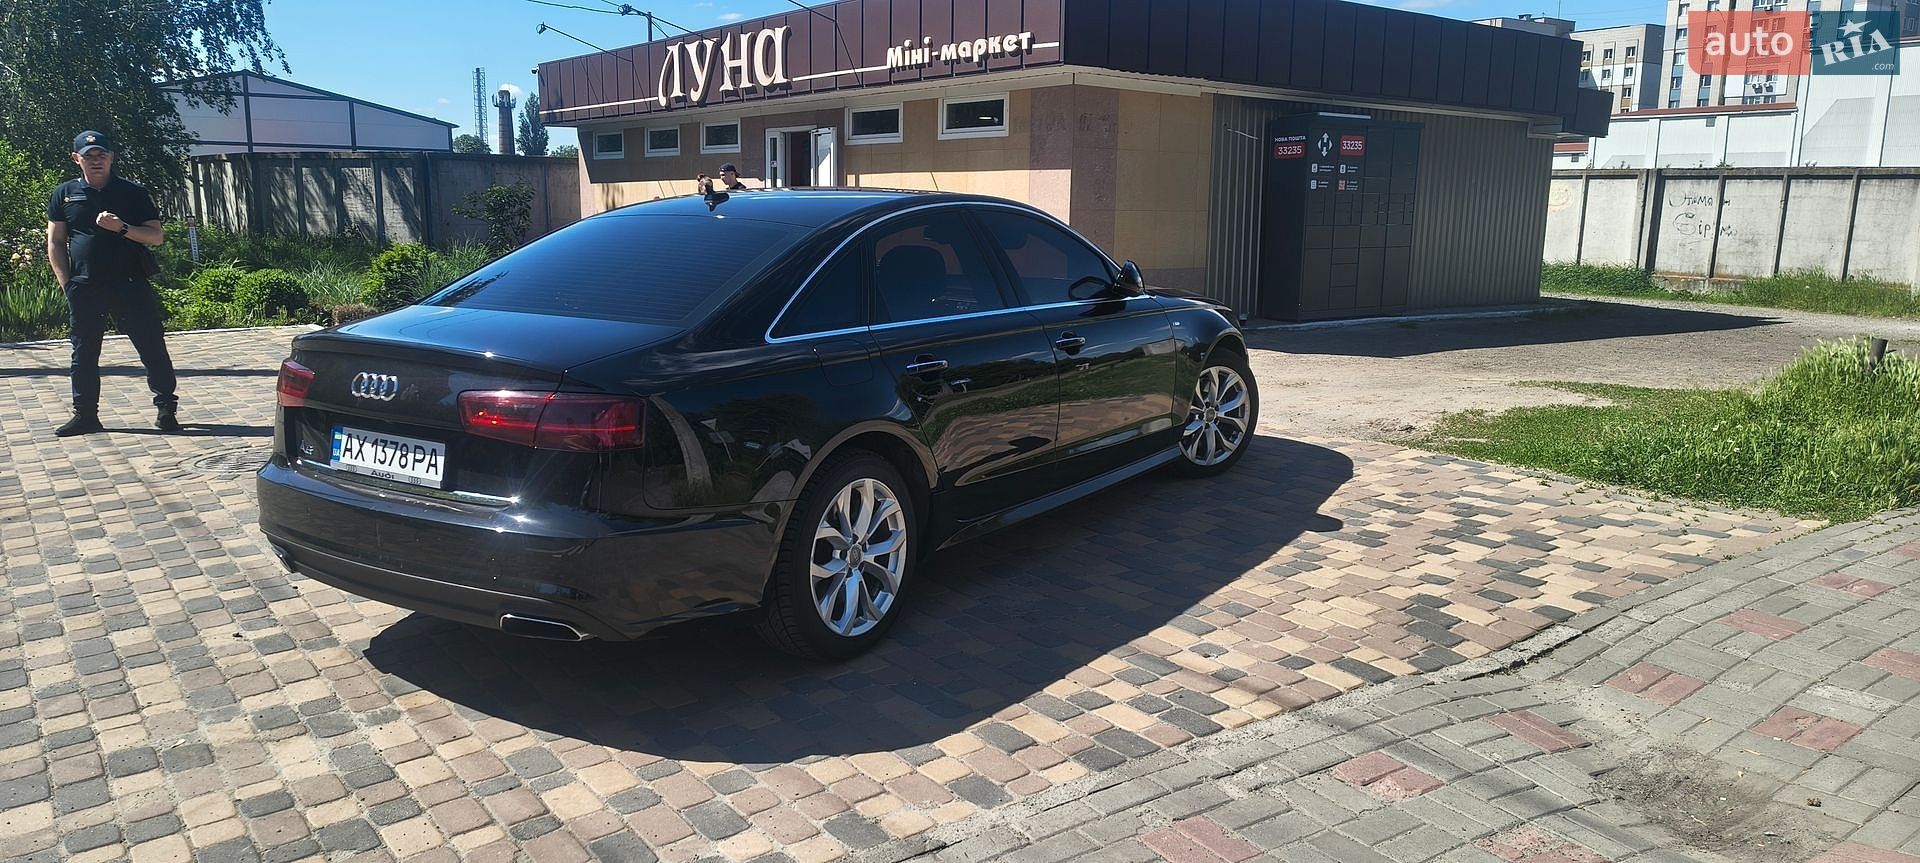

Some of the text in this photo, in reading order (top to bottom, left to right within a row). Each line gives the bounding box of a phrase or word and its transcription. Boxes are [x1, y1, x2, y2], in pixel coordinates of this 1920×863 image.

[886, 31, 1033, 68] Міні-маркет
[1278, 145, 1302, 155] 33235
[1342, 140, 1363, 150] 33235
[342, 433, 439, 475] AX 1378 PA
